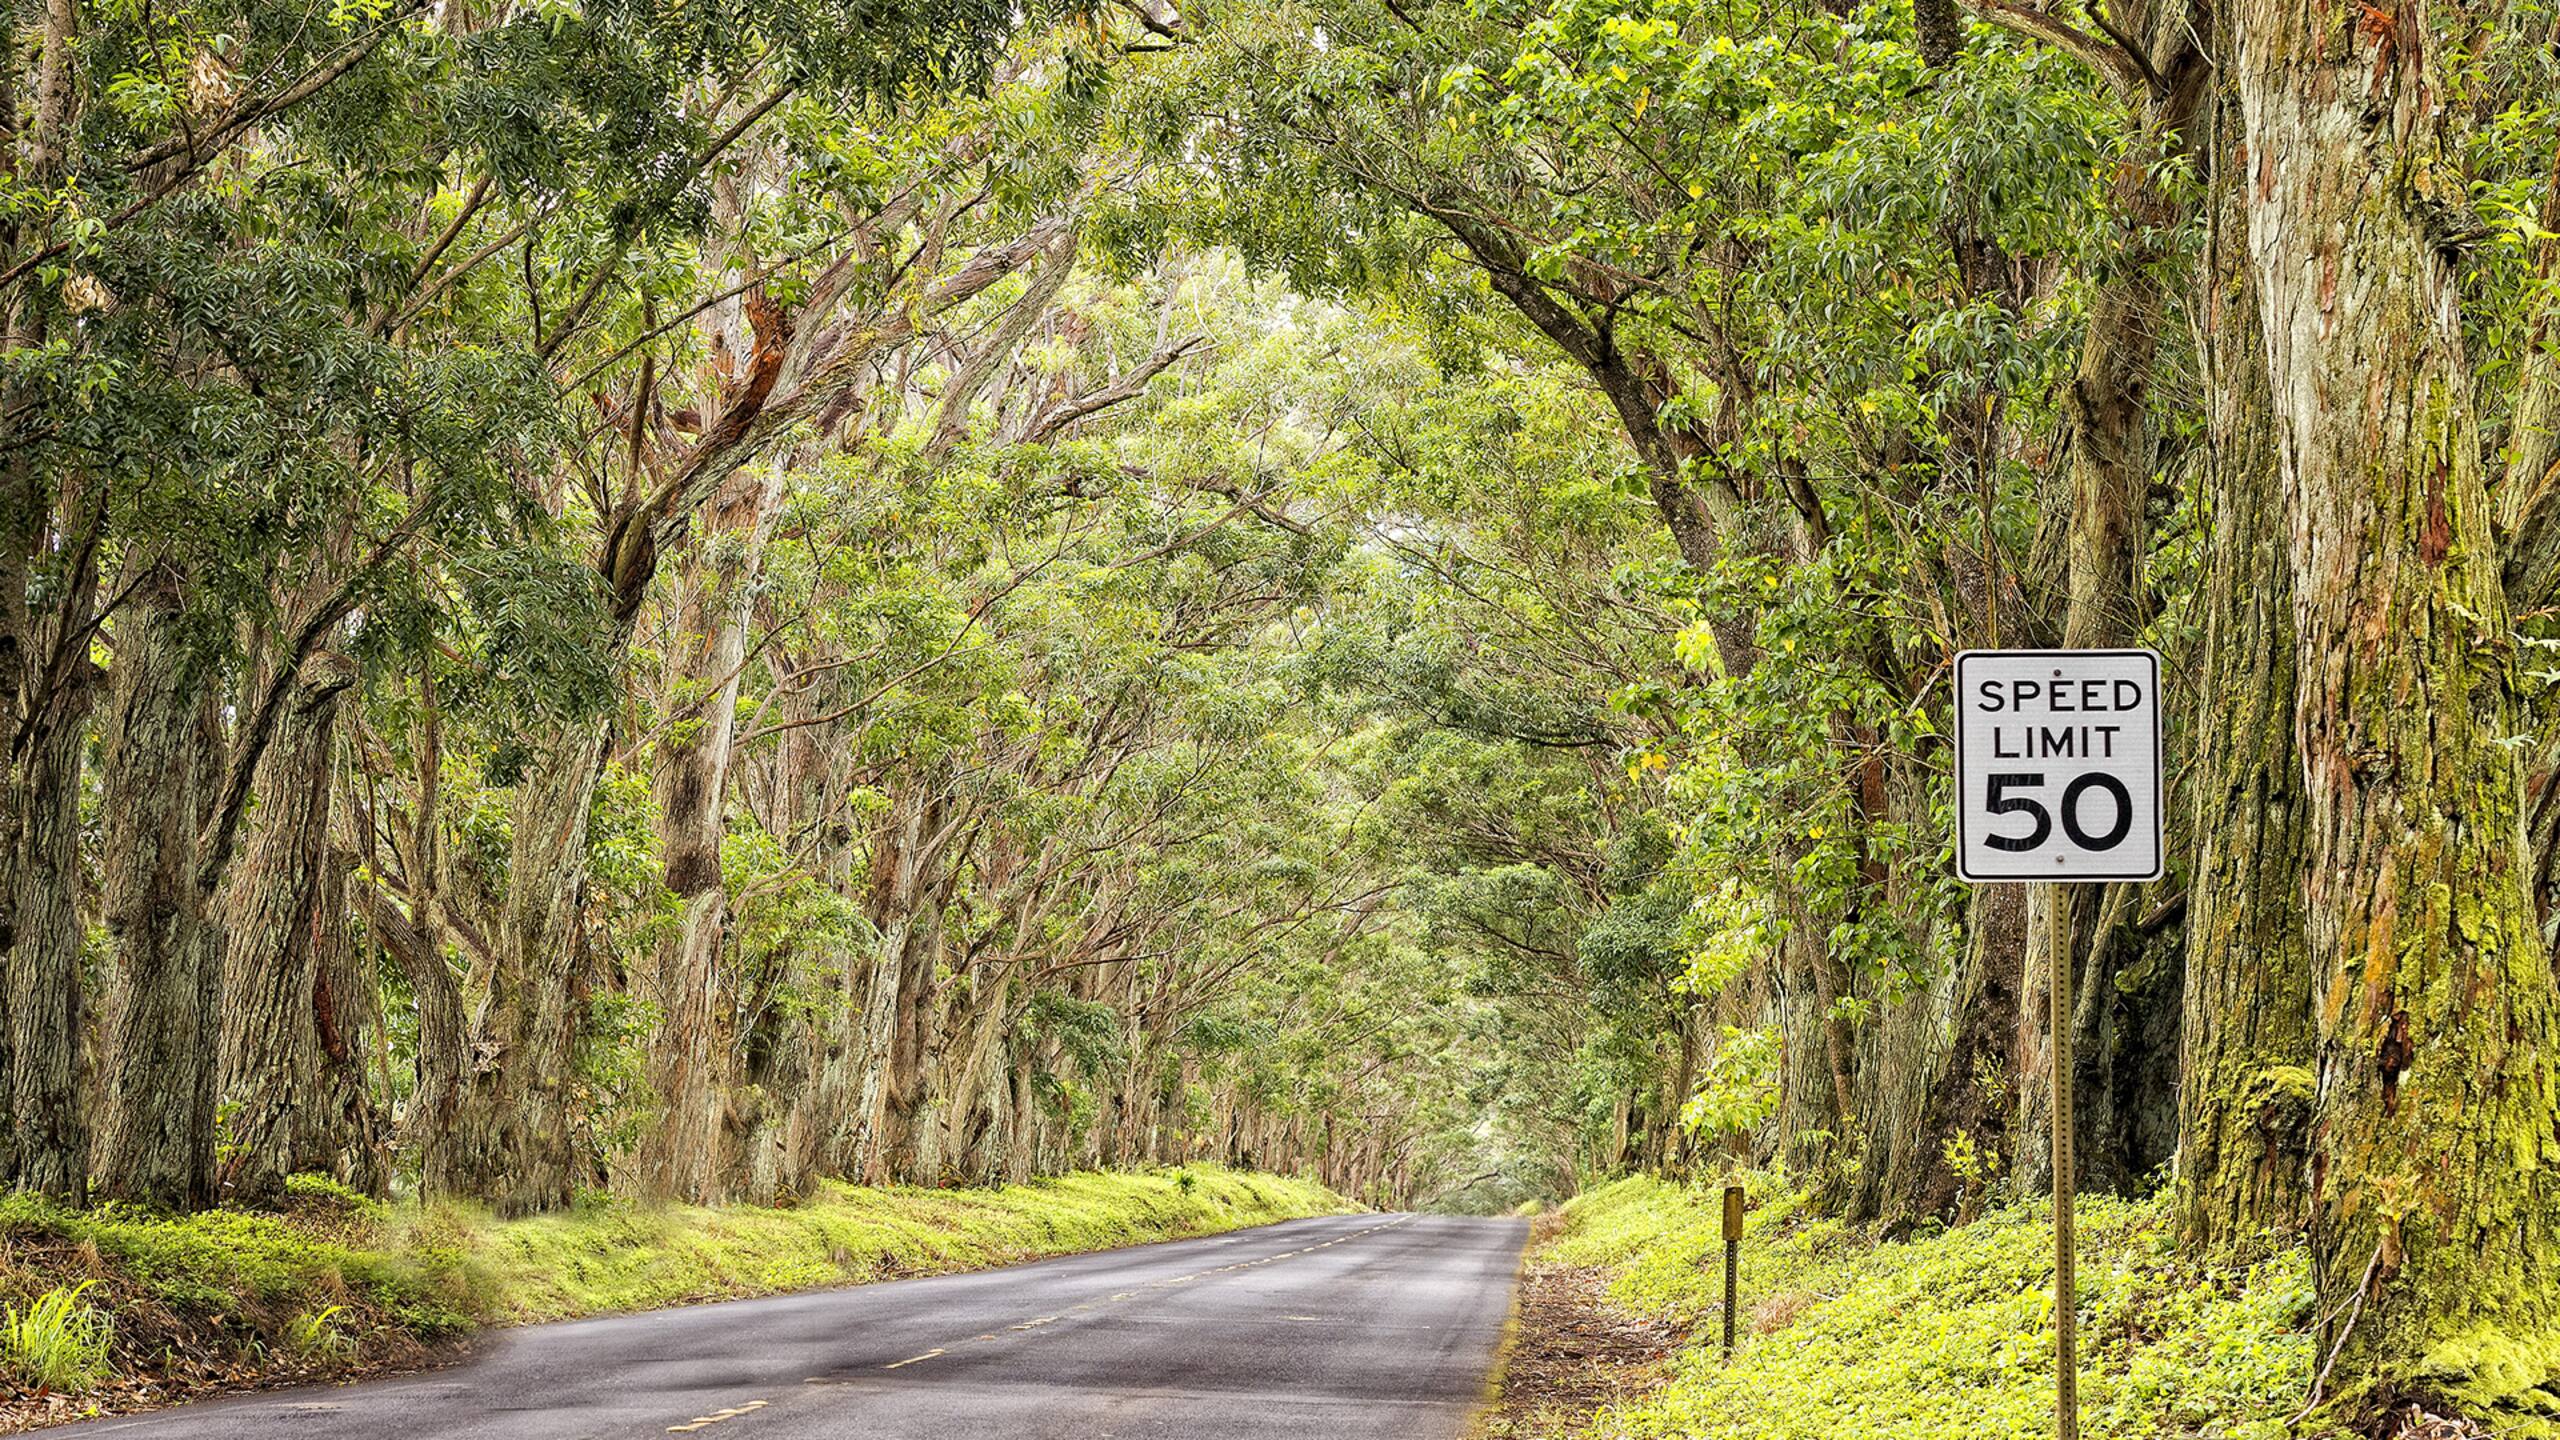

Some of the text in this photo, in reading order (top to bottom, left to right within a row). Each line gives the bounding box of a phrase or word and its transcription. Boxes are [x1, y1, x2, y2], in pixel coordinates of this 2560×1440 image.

[1977, 679, 2142, 713] SPEED
[1994, 726, 2121, 759] LIMIT
[1983, 771, 2133, 853] 50
